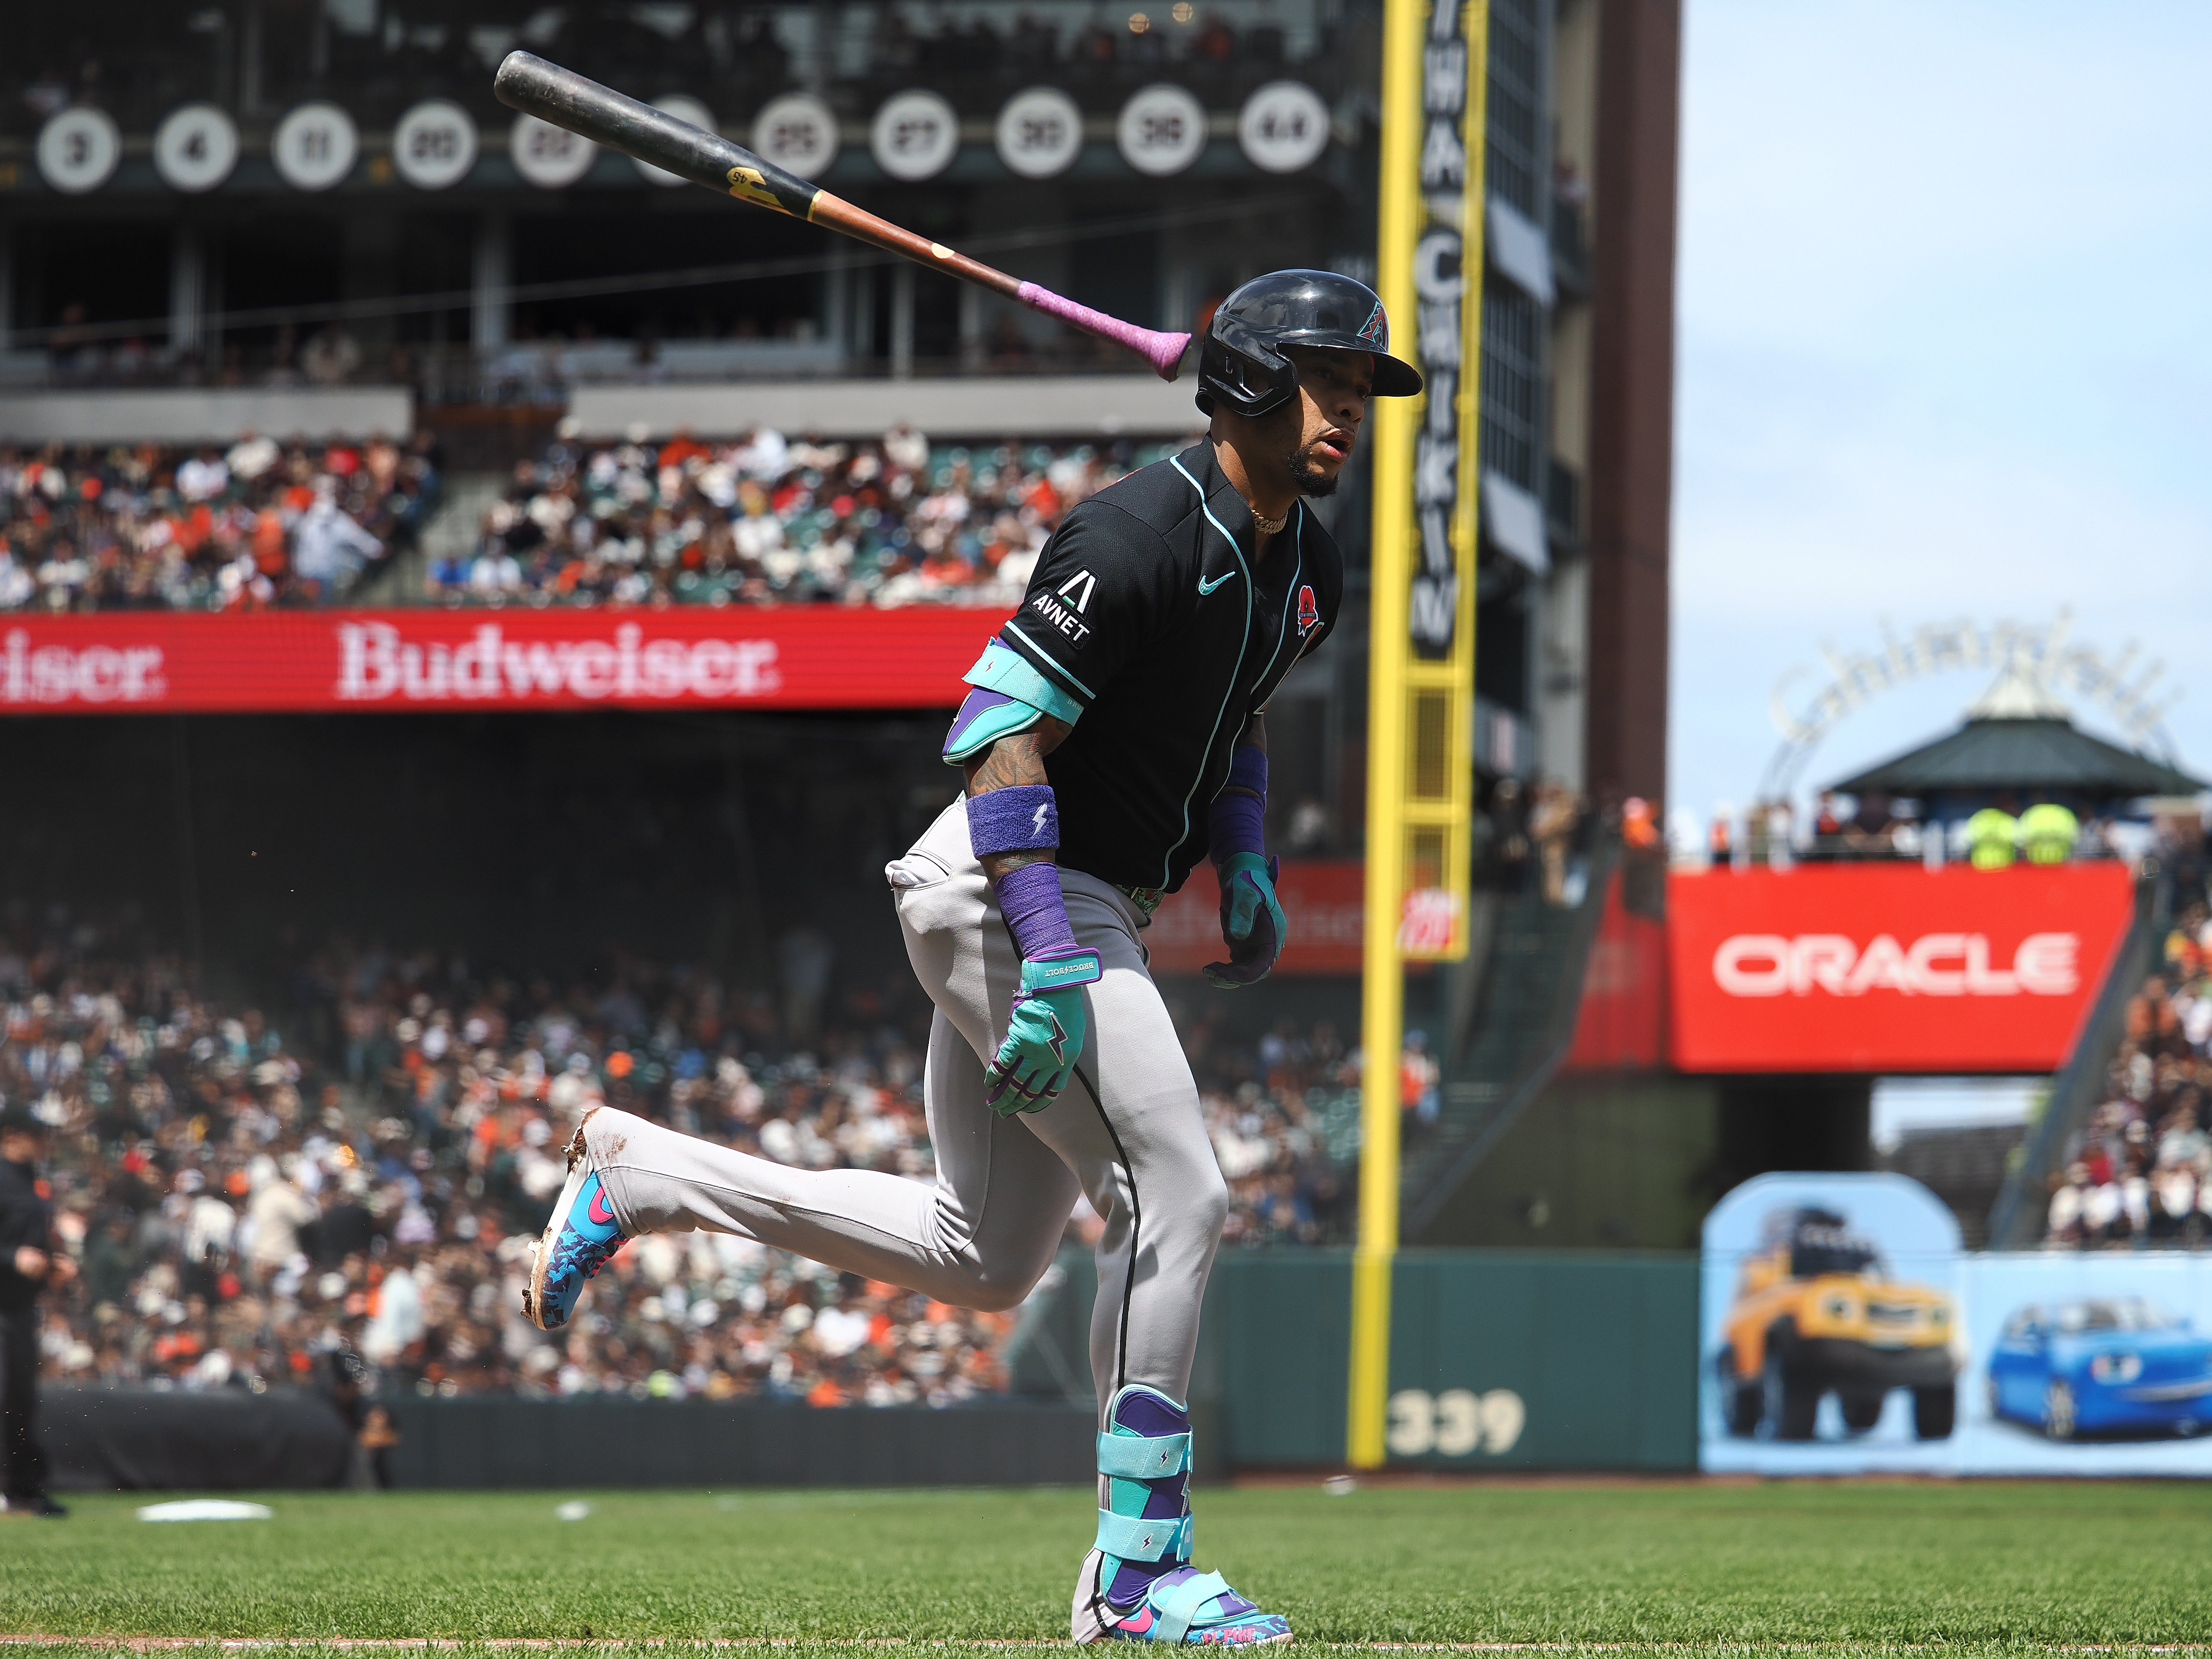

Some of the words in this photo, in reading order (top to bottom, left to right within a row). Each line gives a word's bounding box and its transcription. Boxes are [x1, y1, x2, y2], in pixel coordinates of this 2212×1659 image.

[182, 131, 207, 162] 4
[298, 127, 332, 162] 11
[1256, 110, 1307, 143] 44
[1409, 230, 1470, 649] CHIKIN
[1033, 594, 1090, 640] AVNET
[335, 622, 779, 700] Budweiser
[1045, 967, 1065, 977] BOLT
[1068, 962, 1094, 972] BRUCE
[1712, 933, 2081, 998] ORACLE
[1387, 1387, 1526, 1456] 339
